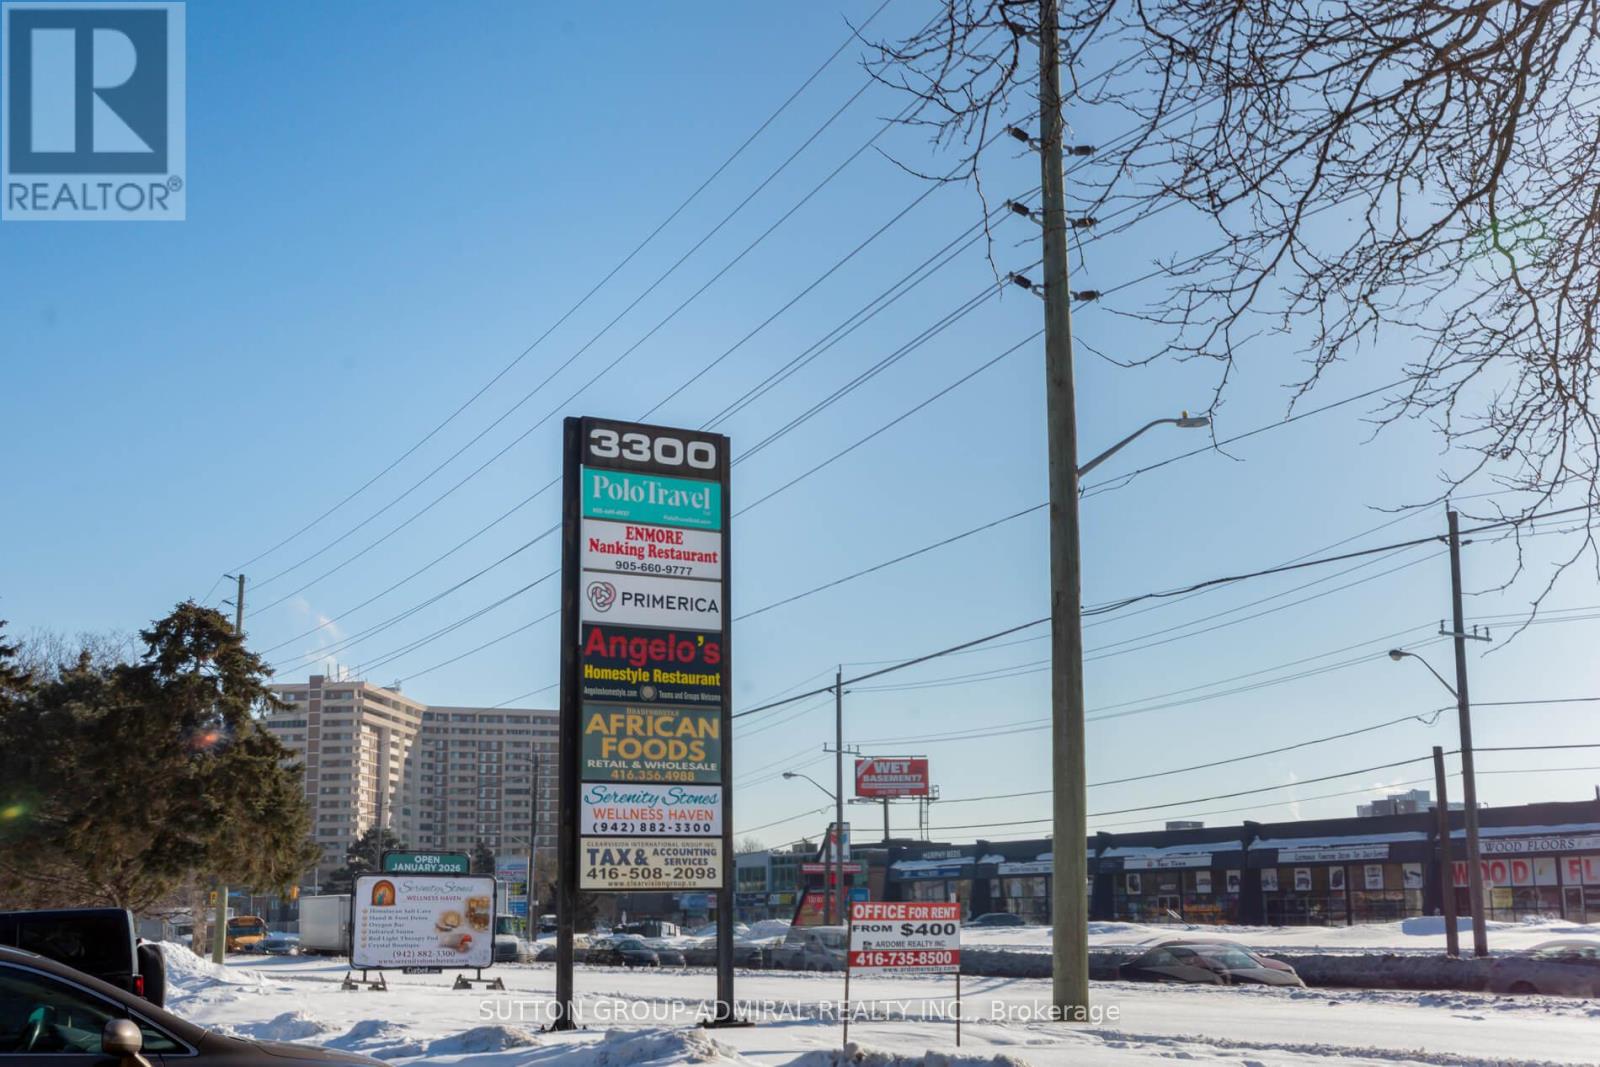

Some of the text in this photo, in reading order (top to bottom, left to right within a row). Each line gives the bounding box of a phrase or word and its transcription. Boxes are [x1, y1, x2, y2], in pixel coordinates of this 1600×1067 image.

[589, 428, 717, 470] 3300
[625, 526, 684, 545] ENMORE
[588, 538, 718, 564] Nanking Restaurant
[615, 560, 693, 576] 905-660-9777
[621, 591, 719, 614] PRIMERICA
[584, 626, 721, 667] Angelo's
[584, 664, 721, 687] Homestyle Restaurant
[585, 713, 720, 740] AFRICAN
[601, 737, 706, 762] FOODS
[587, 759, 718, 771] RETAIL & WHOLESALE
[873, 761, 911, 774] WET
[610, 769, 695, 782] 416.356.4988
[584, 785, 718, 808] Serenity Stones
[593, 808, 714, 821] WELLNESS HAVEN
[592, 822, 711, 833] (942) 882-3300
[1485, 840, 1522, 852] WOOD
[1527, 839, 1575, 851] FLOORS
[414, 855, 441, 863] OPEN
[586, 848, 717, 866] TAX & ACCOUNTING
[664, 857, 709, 867] SERVICES
[392, 863, 462, 872] JANUARY 2026
[586, 867, 717, 880] 416-508-2098
[853, 904, 957, 919] OFFICE FOR RENT
[900, 923, 956, 937] $400
[856, 951, 952, 966] 416-735-8500
